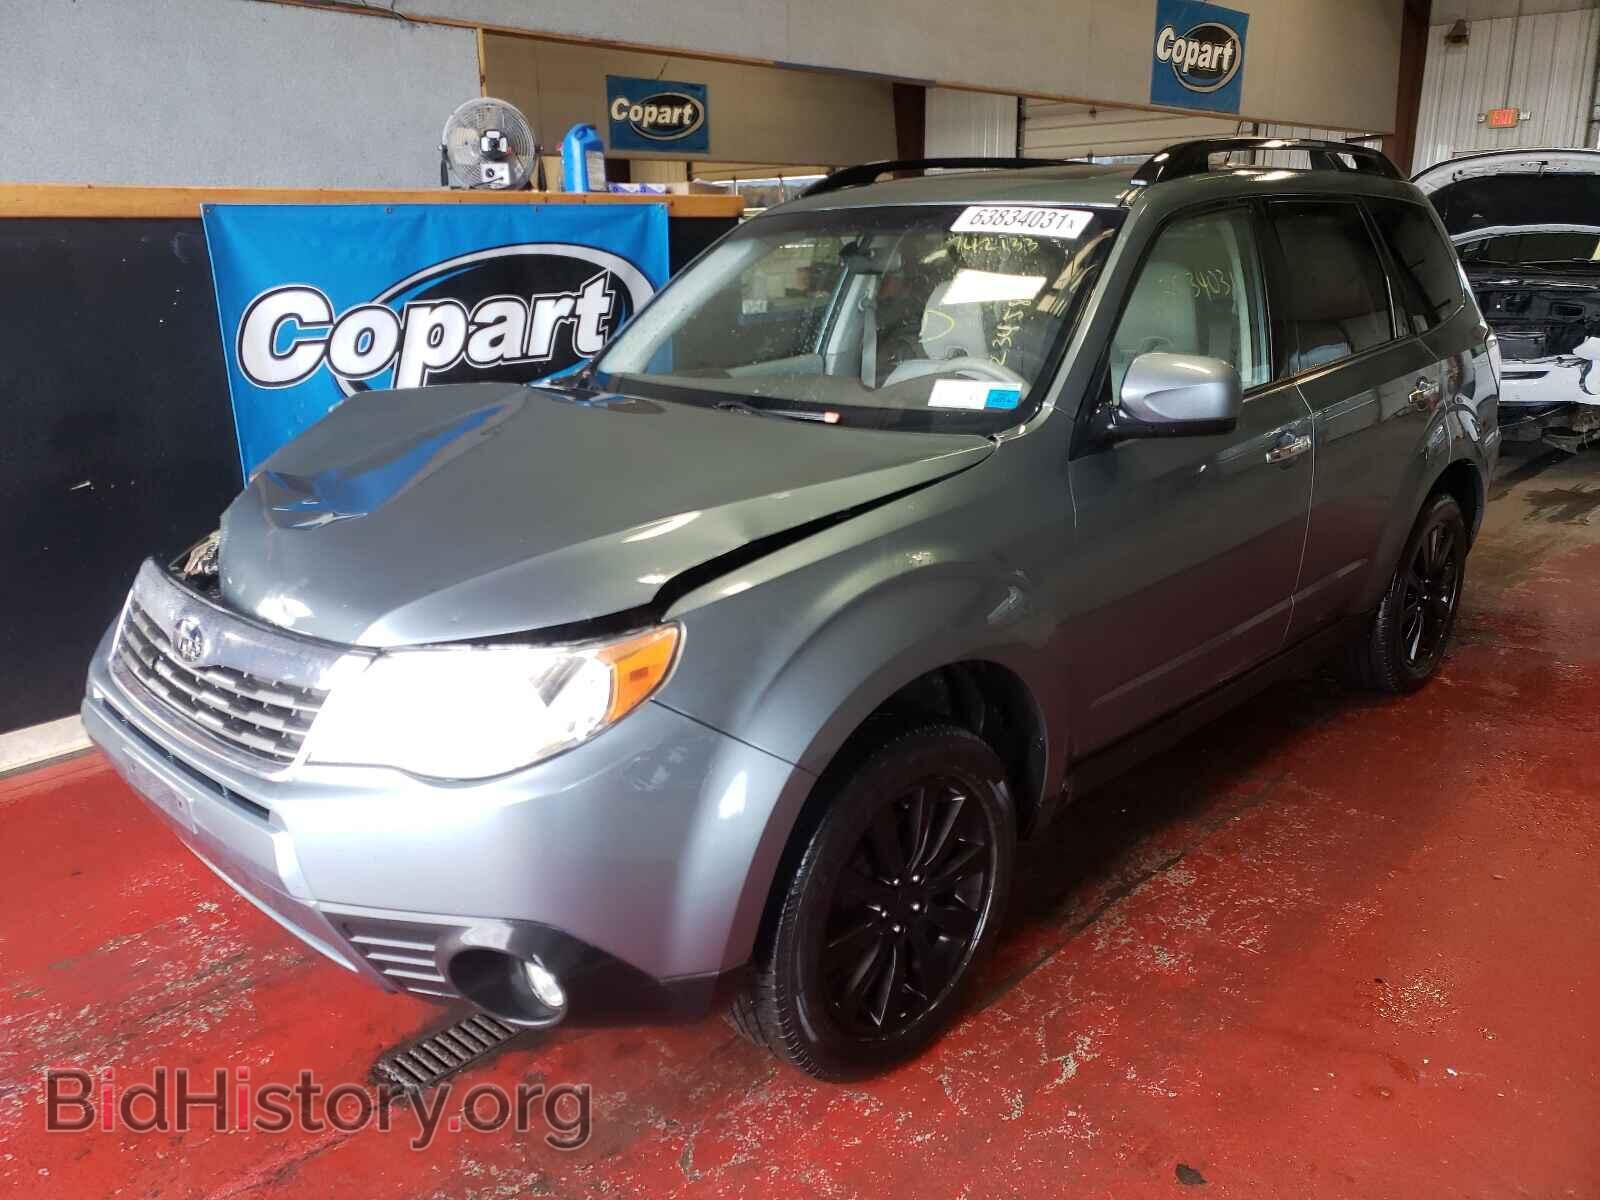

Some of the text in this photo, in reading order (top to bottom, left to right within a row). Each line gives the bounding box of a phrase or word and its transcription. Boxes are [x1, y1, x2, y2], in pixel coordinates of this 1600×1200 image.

[1156, 26, 1233, 73] Copart
[610, 97, 693, 128] Copart
[970, 208, 1069, 231] 63834031
[238, 274, 613, 388] Copart
